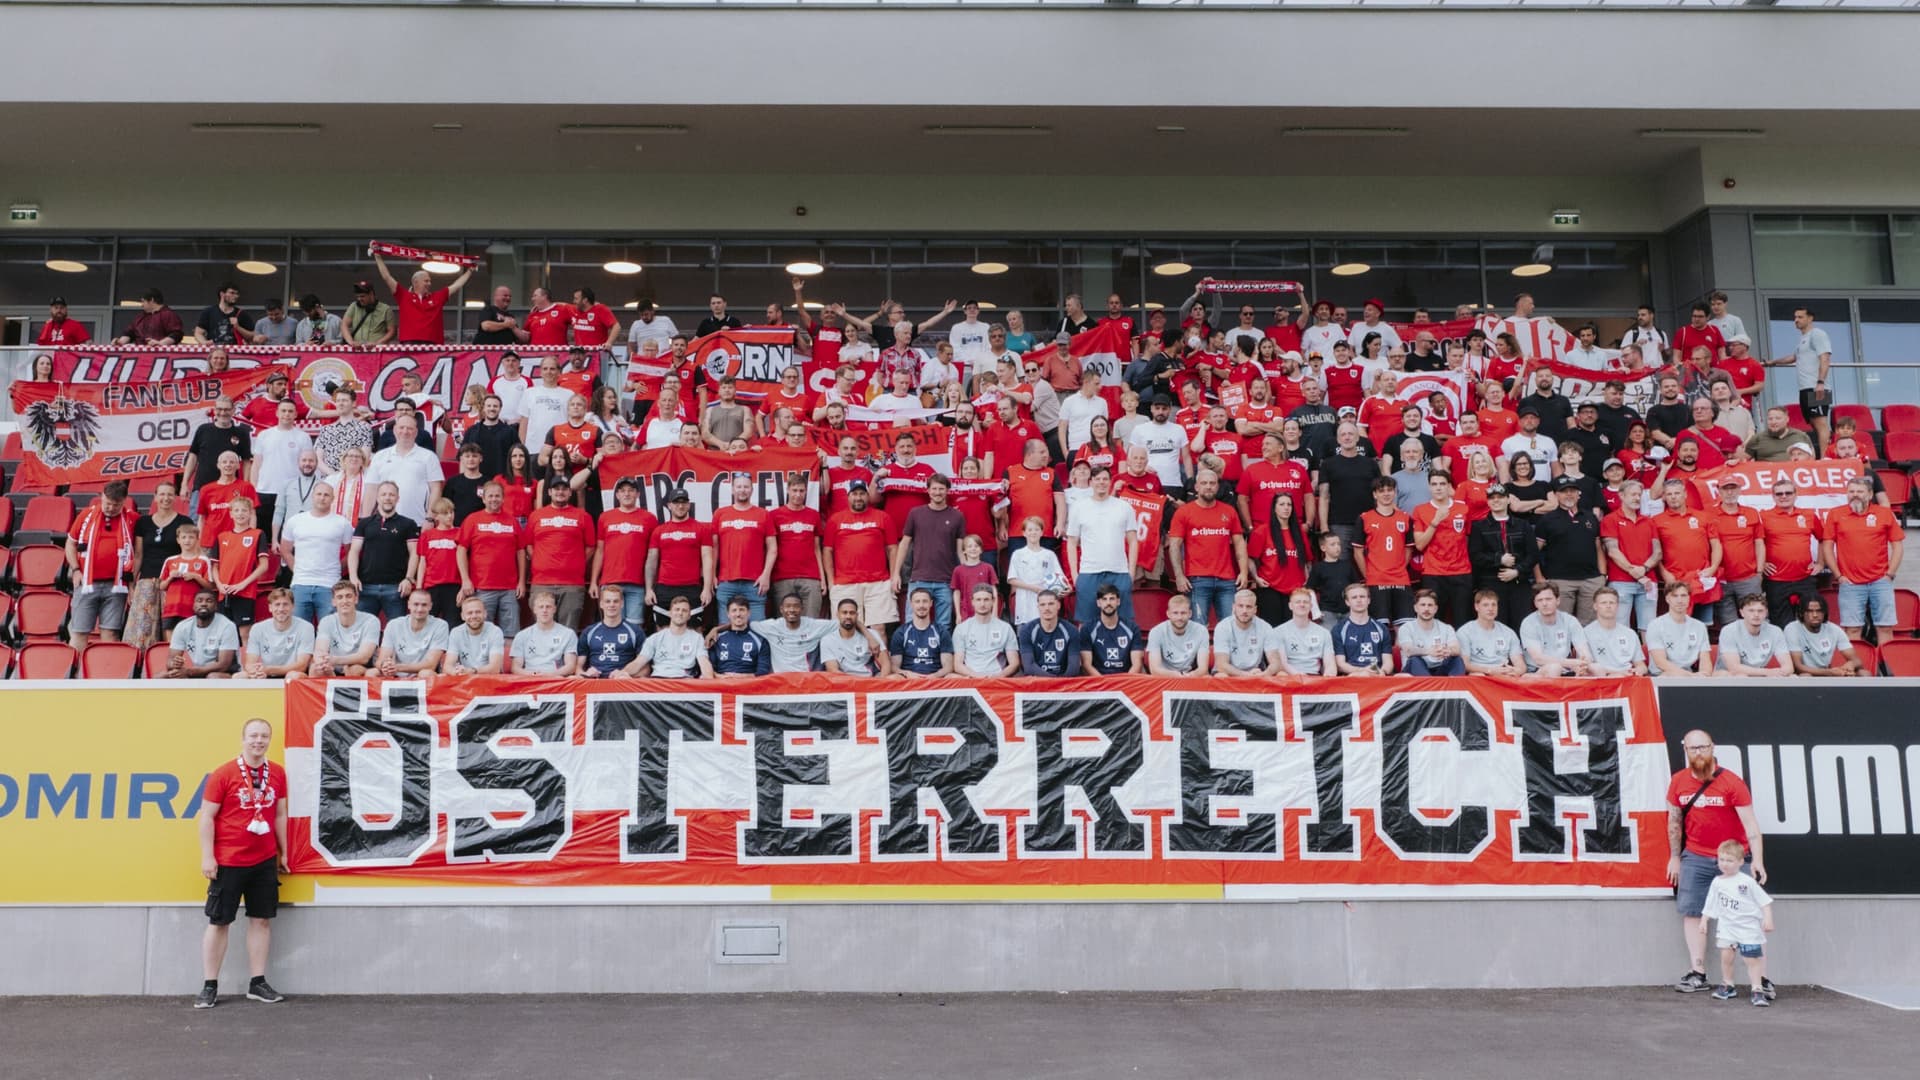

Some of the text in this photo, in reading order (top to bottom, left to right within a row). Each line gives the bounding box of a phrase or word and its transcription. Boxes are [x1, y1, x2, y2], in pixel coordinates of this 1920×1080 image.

[103, 379, 222, 409] FANCLUB
[137, 418, 190, 443] OED
[102, 450, 191, 475] ZEILLE
[1706, 468, 1857, 499] RD EAGLES
[1384, 536, 1394, 553] 8
[310, 680, 1640, 867] ÖSTERREICH
